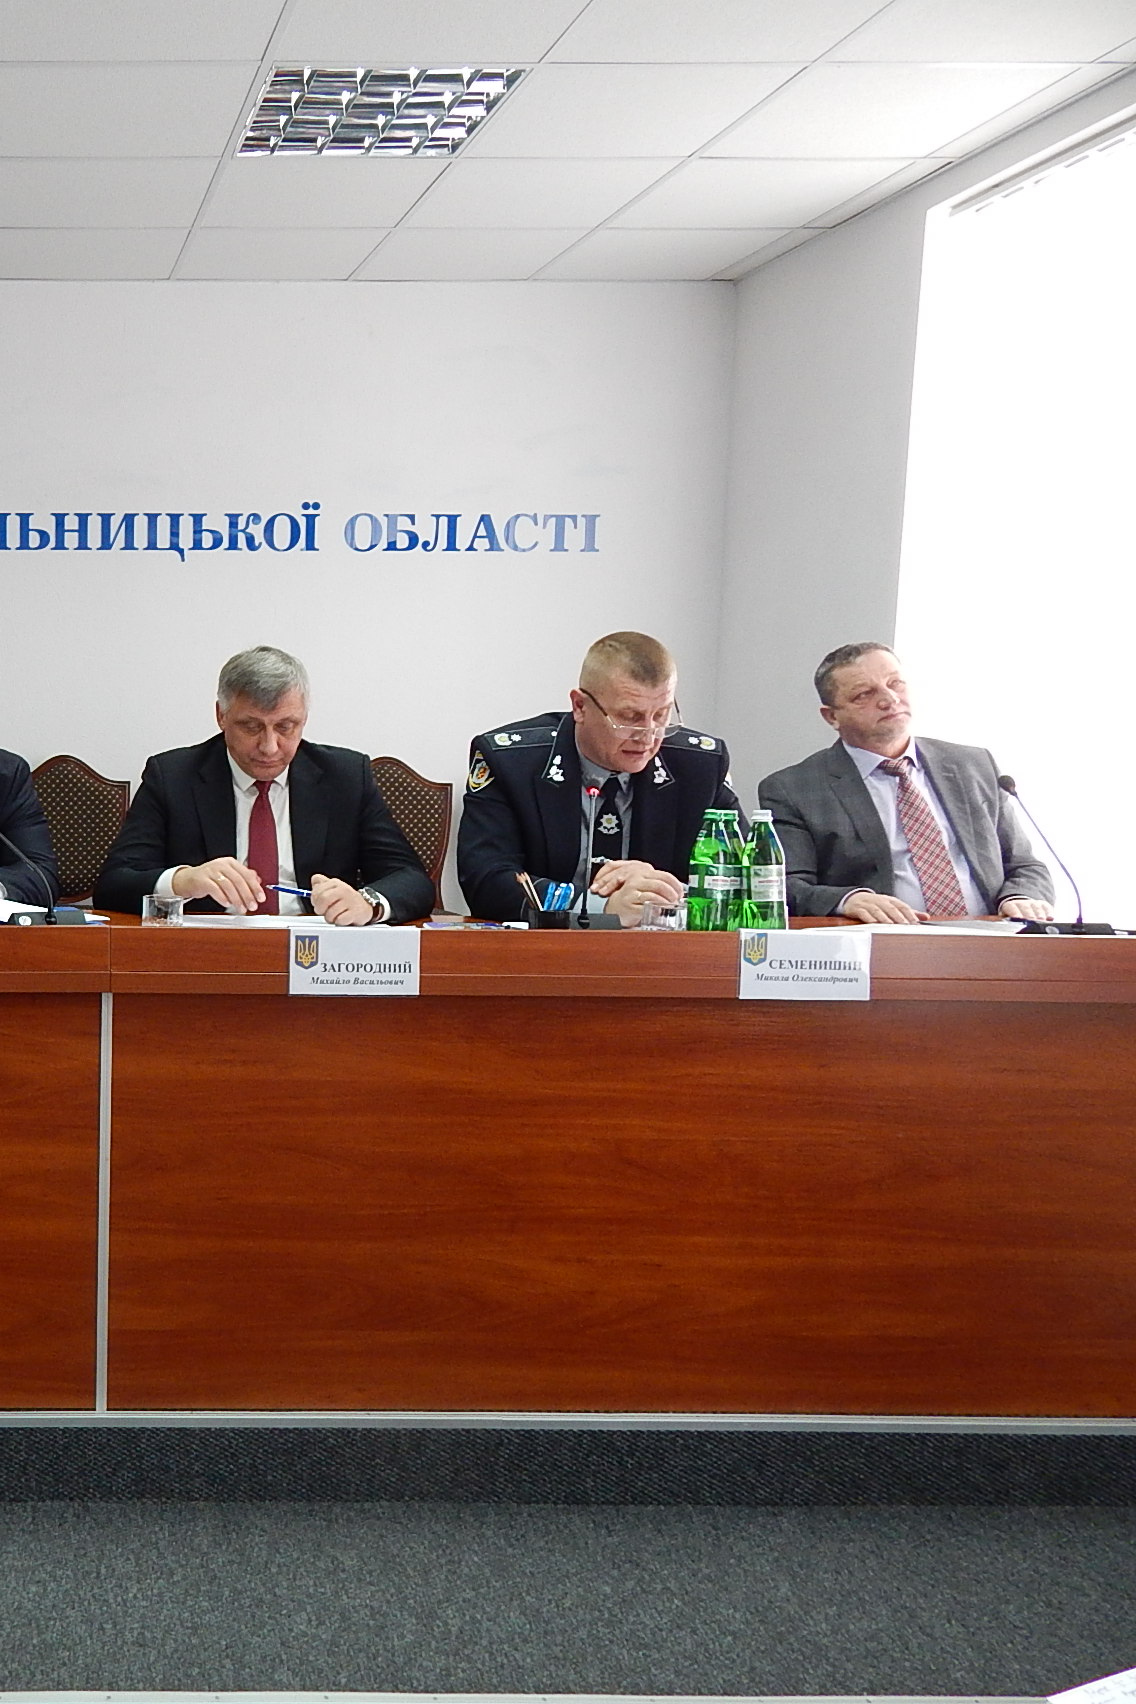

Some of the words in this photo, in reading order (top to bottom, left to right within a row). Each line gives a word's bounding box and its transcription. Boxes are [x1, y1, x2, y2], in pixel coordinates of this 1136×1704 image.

[344, 512, 600, 553] ОБЛАСТІ
[320, 961, 412, 974] ЗАГОРОДНИЙ
[768, 959, 862, 971] СЕМЕНИШИН
[310, 976, 350, 986] Михайло
